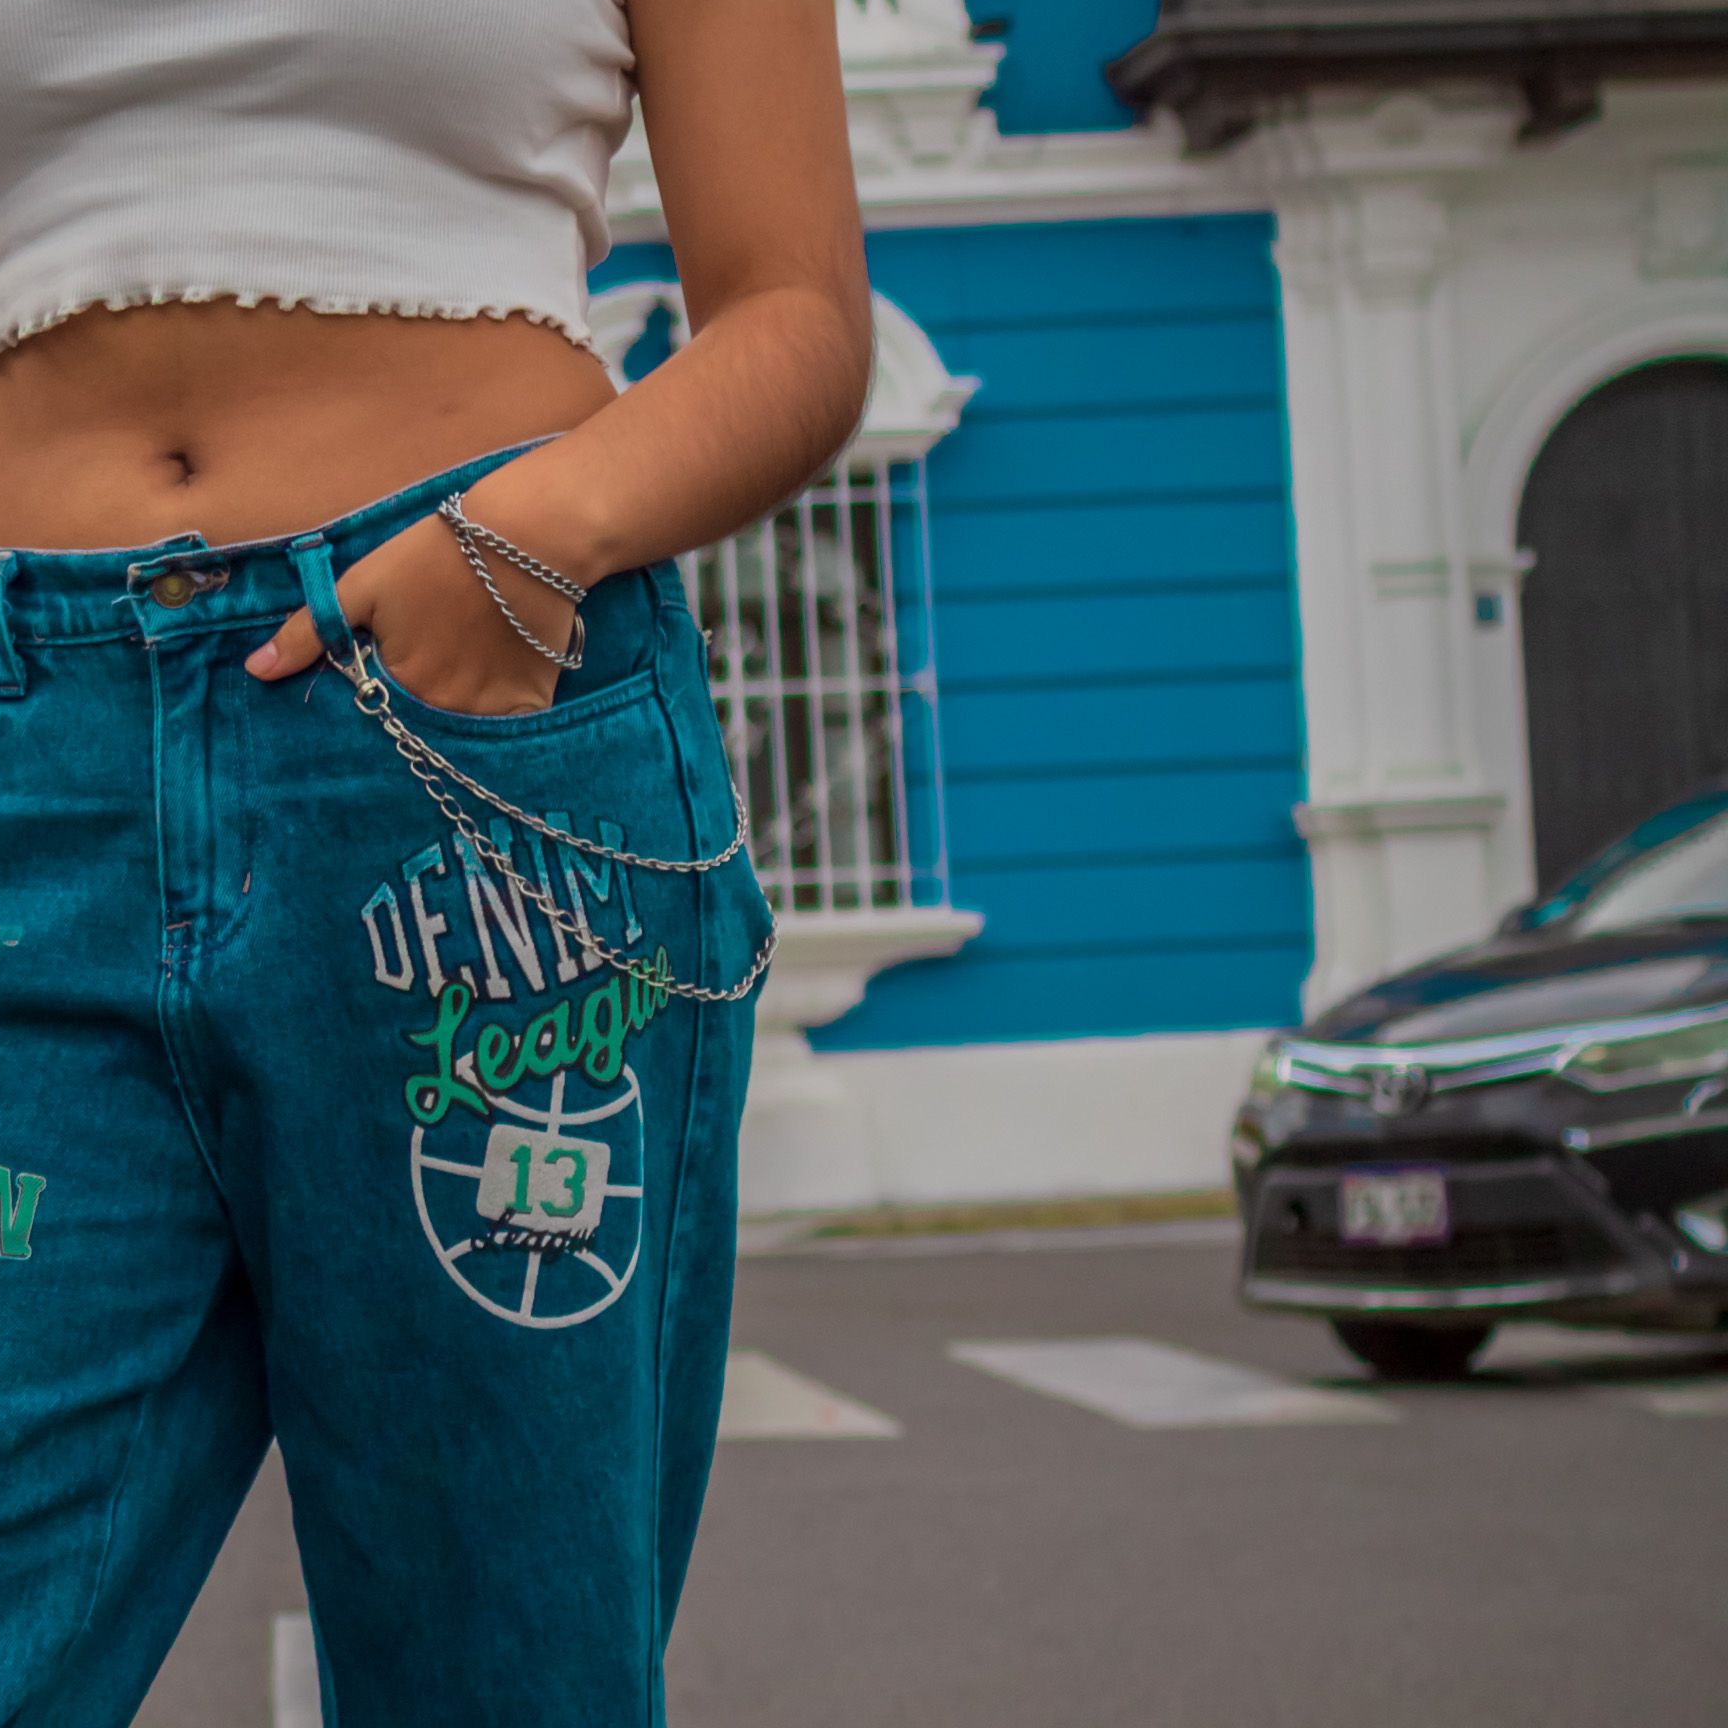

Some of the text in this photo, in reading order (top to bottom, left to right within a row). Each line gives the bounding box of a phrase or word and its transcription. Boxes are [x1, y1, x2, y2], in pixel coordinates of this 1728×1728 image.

[361, 811, 643, 999] DENIM
[404, 943, 671, 1125] League
[508, 1143, 588, 1218] 13
